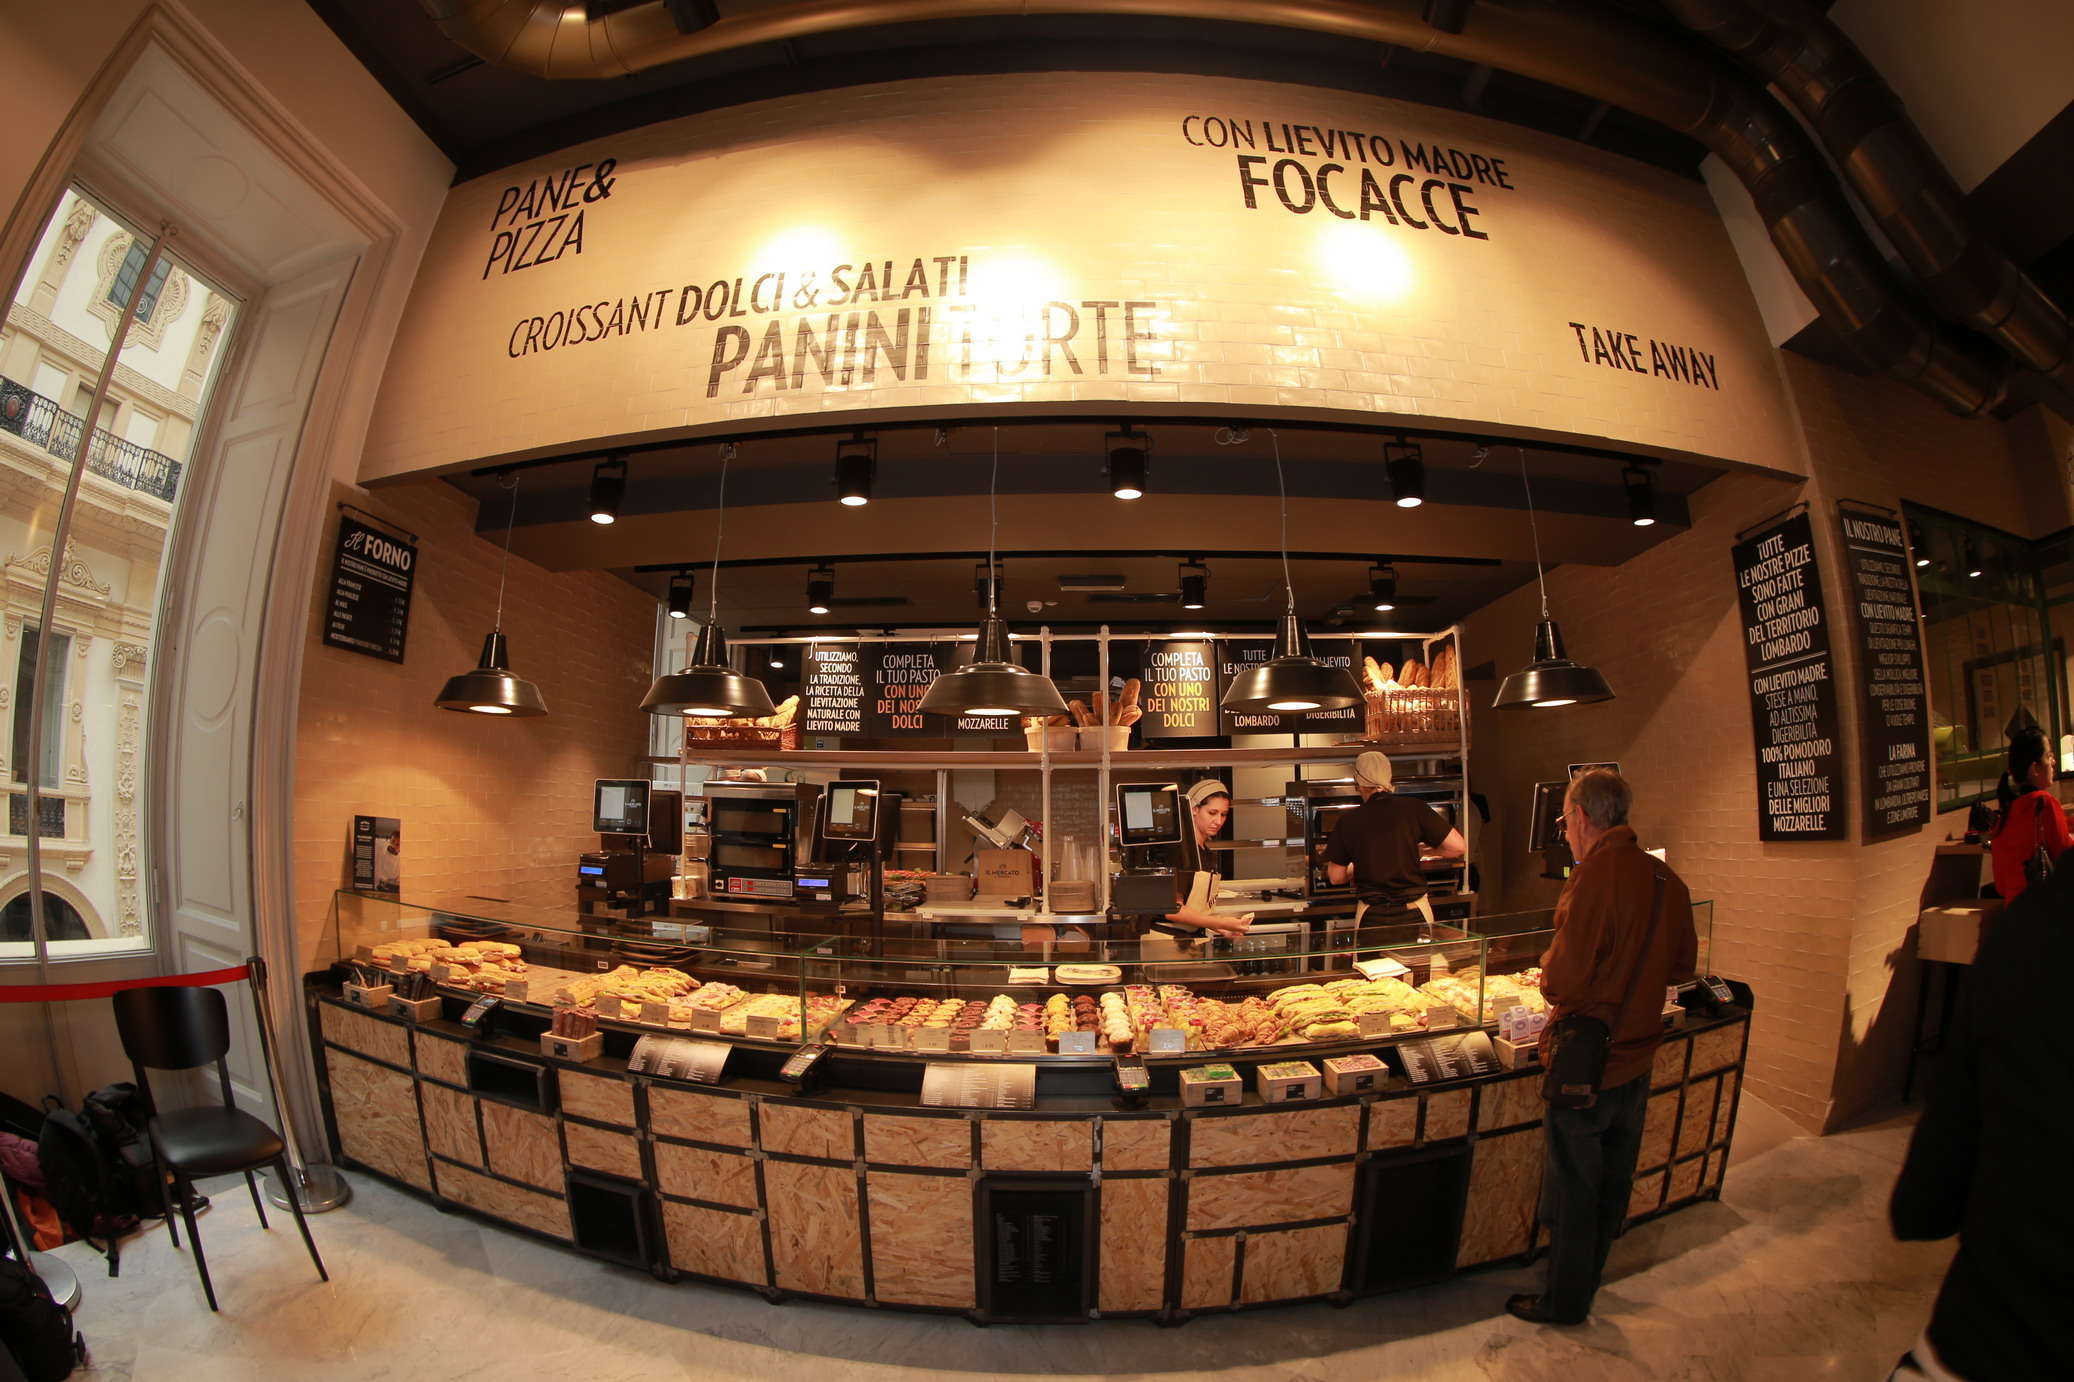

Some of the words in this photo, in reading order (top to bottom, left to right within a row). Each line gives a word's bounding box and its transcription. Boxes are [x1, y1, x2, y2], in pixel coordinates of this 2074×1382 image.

[1183, 115, 1256, 149] CON
[1263, 121, 1395, 167] LIEVITO
[1400, 139, 1515, 190] MADRE
[1237, 154, 1489, 241] FOCACCE
[482, 209, 585, 281] PIZZA
[508, 289, 674, 358] CROISSANT
[675, 272, 785, 326] DOLCI
[793, 271, 819, 308] &
[826, 255, 968, 306] SALATI
[706, 305, 932, 398] PANINI
[1568, 321, 1648, 375] TAKE
[1649, 339, 1719, 391] AWAY
[1843, 518, 1854, 539] IL
[1852, 520, 1884, 543] NOSTRO
[1882, 526, 1904, 547] PANE
[364, 534, 411, 571] FORNO
[1756, 534, 1785, 561] TUTTE
[1740, 569, 1751, 589] LE
[1750, 555, 1785, 584] NOSTRE
[1784, 543, 1812, 570] PIZZE
[1752, 579, 1777, 604] SONO
[1776, 568, 1805, 595] FATTE
[1757, 600, 1776, 621] CON
[1775, 589, 1805, 615] GRANI
[1749, 624, 1766, 645] DEL
[1765, 606, 1819, 640] TERRITORIO
[1242, 649, 1267, 661] TUTTE
[1761, 630, 1811, 662] LOMBARDO
[819, 662, 853, 673] SECONDO
[883, 654, 935, 669] COMPLETA
[1151, 651, 1204, 667] COMPLETA
[876, 669, 885, 684] IL
[887, 670, 908, 684] TUO
[909, 669, 941, 684] PASTO
[1144, 667, 1154, 682] IL
[1155, 667, 1177, 682] TUO
[1179, 666, 1211, 681] PASTO
[1223, 662, 1233, 674] LE
[1234, 663, 1264, 675] NOSTR
[810, 674, 818, 685] LA
[1753, 676, 1770, 695] CON
[1769, 670, 1797, 691] LIEVITO
[805, 685, 814, 696] LA
[815, 686, 843, 696] RICETTA
[843, 686, 865, 697] DELLA
[884, 684, 906, 698] CON
[1154, 682, 1176, 697] CON
[1178, 682, 1203, 697] UNO
[810, 697, 859, 708] LIEVITAZIONE
[877, 699, 895, 714] DEI
[1147, 698, 1166, 712] DEI
[1170, 697, 1210, 712] NOSTRI
[1765, 691, 1787, 711] STESE
[1787, 689, 1794, 706] A
[807, 708, 844, 719] NATURALE
[845, 709, 861, 720] CON
[892, 714, 923, 729] DOLCI
[1163, 712, 1195, 728] DOLCI
[1234, 714, 1280, 727] LOMBARDO
[1769, 710, 1780, 727] AD
[1781, 704, 1818, 725] ALTISSIMA
[806, 720, 834, 731] LIEVITO
[834, 721, 861, 732] MADRE
[957, 718, 1009, 730] MOZZARELLE
[1761, 746, 1783, 764] 100%
[1783, 738, 1832, 761] POMODORO
[1888, 744, 1897, 761] LA
[1778, 759, 1816, 780] ITALIANO
[1767, 782, 1773, 798] E
[1773, 781, 1790, 798] UNA
[1790, 776, 1830, 796] SELEZIONE
[1769, 798, 1793, 815] DELLE
[1793, 795, 1831, 814] MIGLIORI
